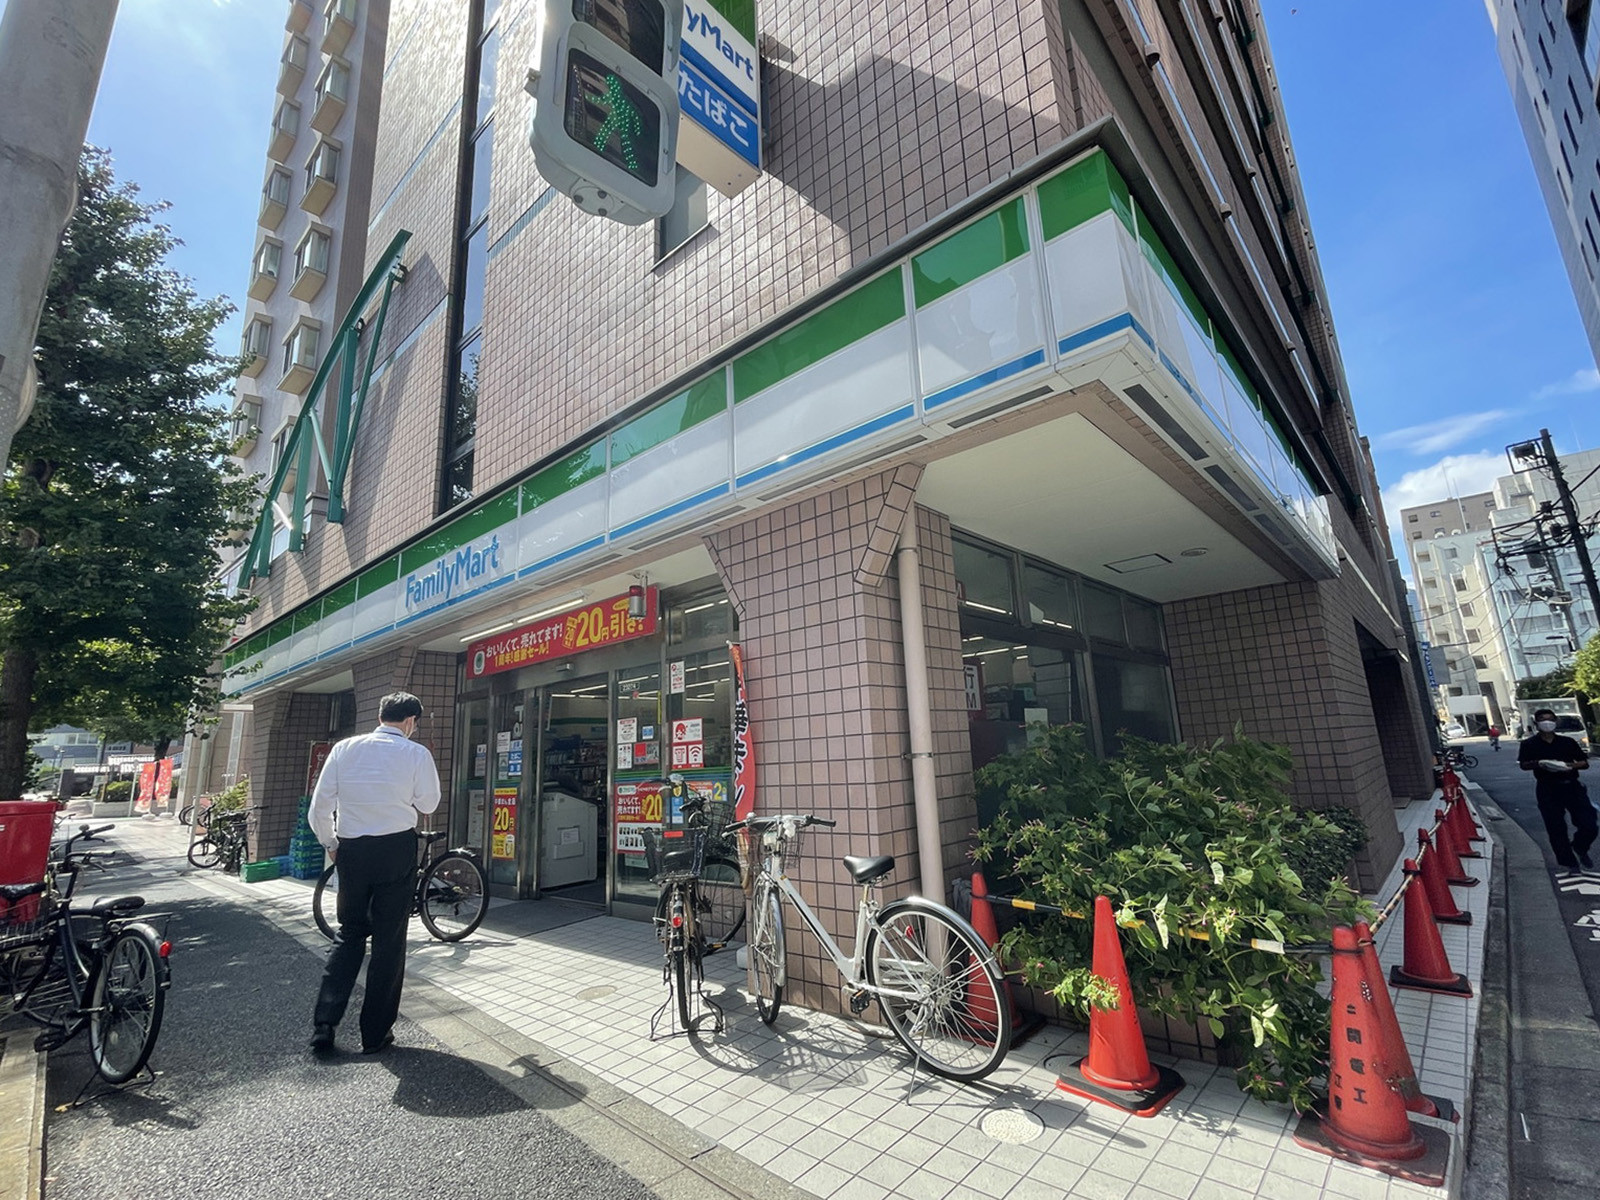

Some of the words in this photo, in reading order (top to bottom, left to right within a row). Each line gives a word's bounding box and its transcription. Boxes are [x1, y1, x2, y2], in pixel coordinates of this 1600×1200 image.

[684, 4, 754, 82] yMart
[679, 68, 749, 147] たばこ
[405, 534, 500, 608] FamilyMart
